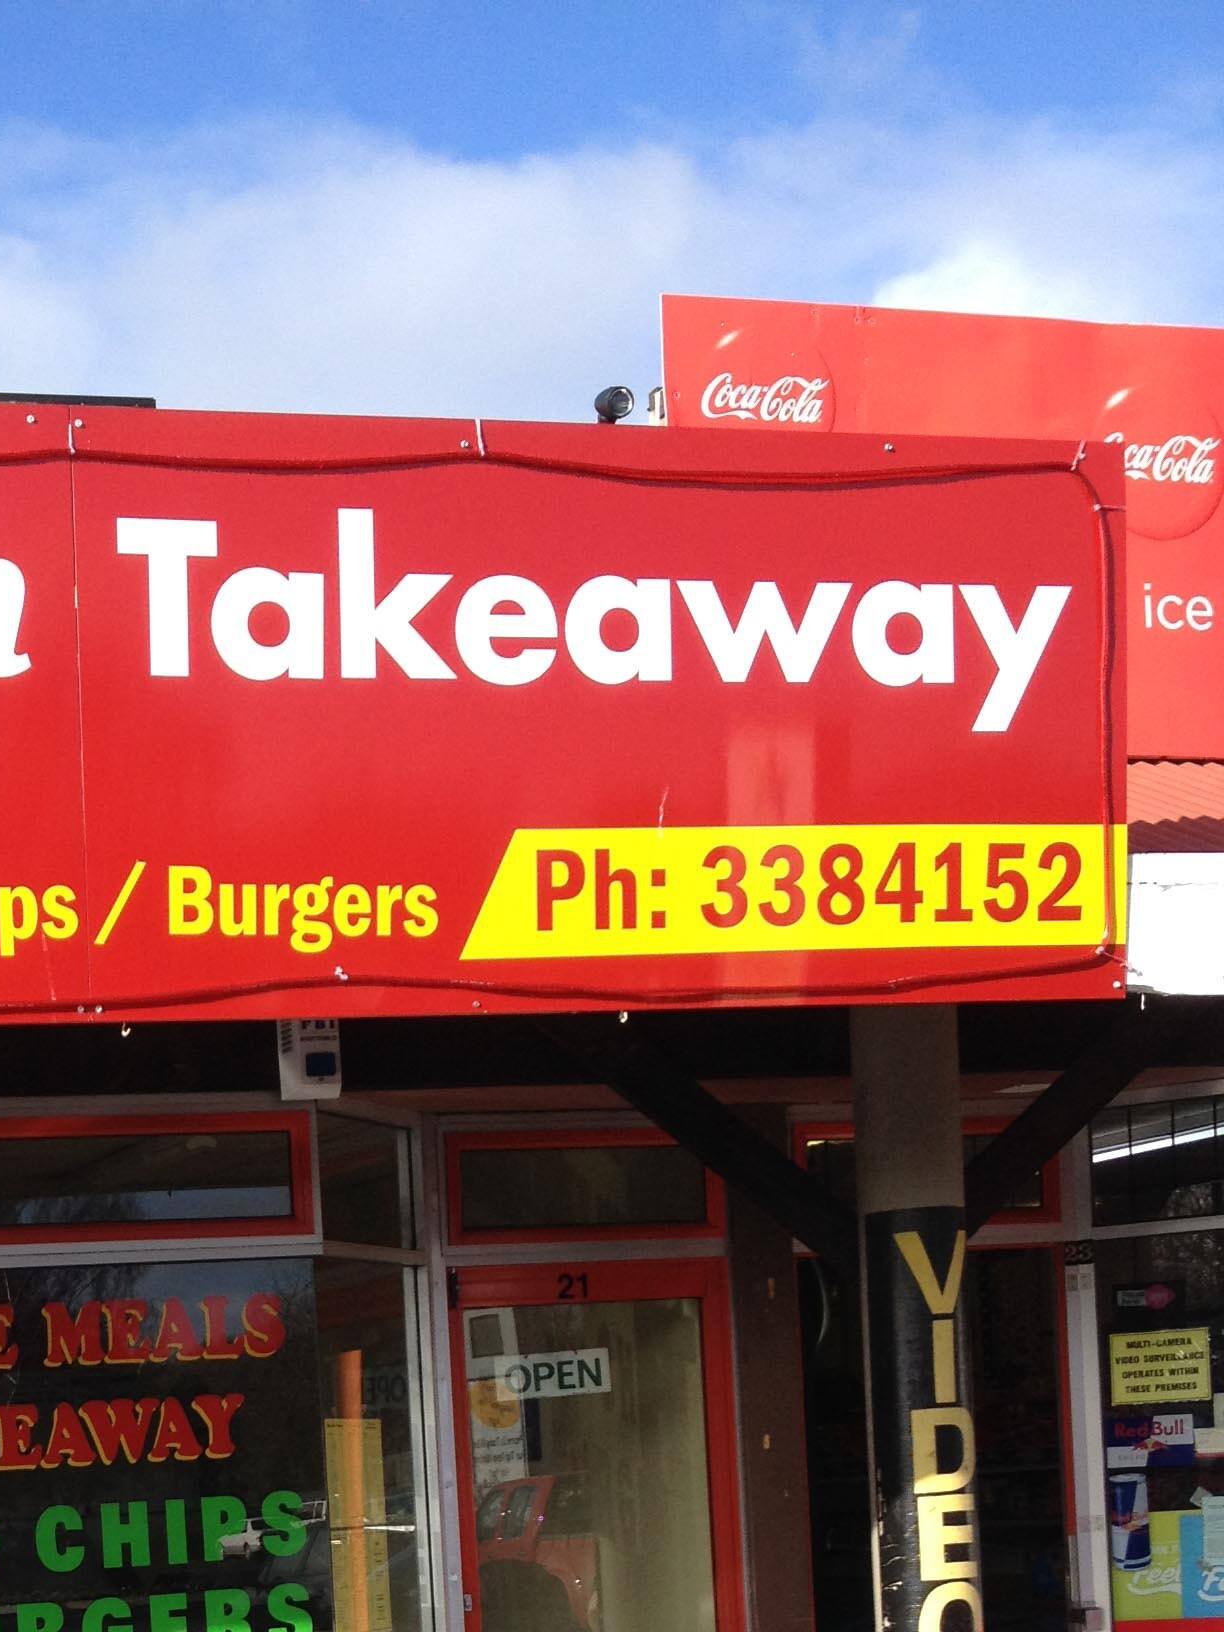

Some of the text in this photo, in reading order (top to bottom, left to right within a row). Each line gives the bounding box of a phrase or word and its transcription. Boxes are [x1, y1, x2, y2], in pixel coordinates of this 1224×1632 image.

[701, 372, 830, 423] Coca-Cola
[1104, 432, 1221, 484] ca-Cola
[116, 508, 1074, 734] Takeaway
[1143, 582, 1215, 632] ice
[94, 860, 147, 945] /
[167, 865, 439, 955] Burgers
[535, 842, 1084, 932] Ph: 3384152
[557, 1273, 589, 1299] 21
[40, 1291, 287, 1367] MEALS
[504, 1357, 603, 1394] OPEN
[1115, 1355, 1140, 1365] VIDEO
[1121, 1366, 1199, 1379] OPERATES WITHIN
[1125, 1381, 1198, 1394] THESE PREMISES
[1114, 1418, 1185, 1438] Red Bull
[34, 1490, 308, 1573] CHIPS
